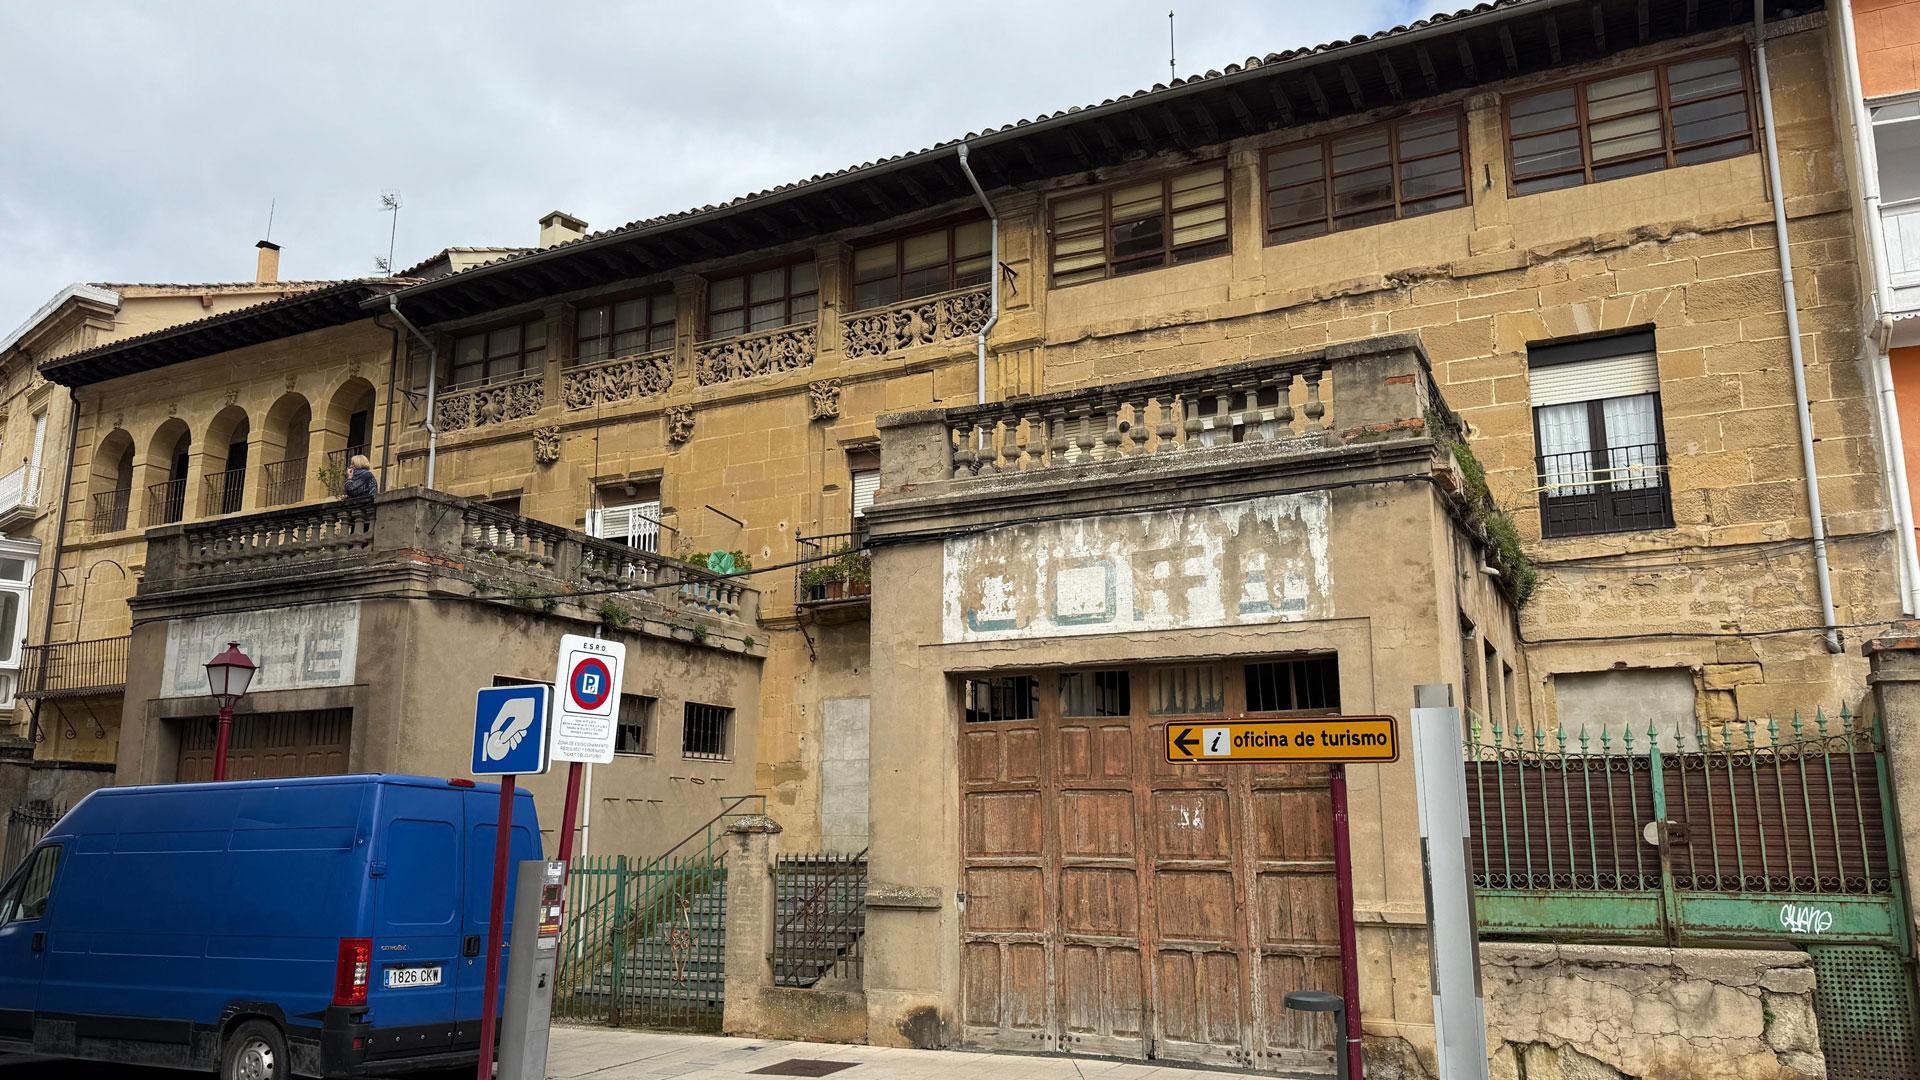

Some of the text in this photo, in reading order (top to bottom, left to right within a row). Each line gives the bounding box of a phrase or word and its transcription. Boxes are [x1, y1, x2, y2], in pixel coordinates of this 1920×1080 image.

[585, 675, 596, 691] P
[1234, 731, 1289, 748] oficina
[1294, 731, 1315, 747] de
[1321, 729, 1388, 747] turismo
[392, 970, 417, 984] 1826
[420, 969, 439, 982] CKW
